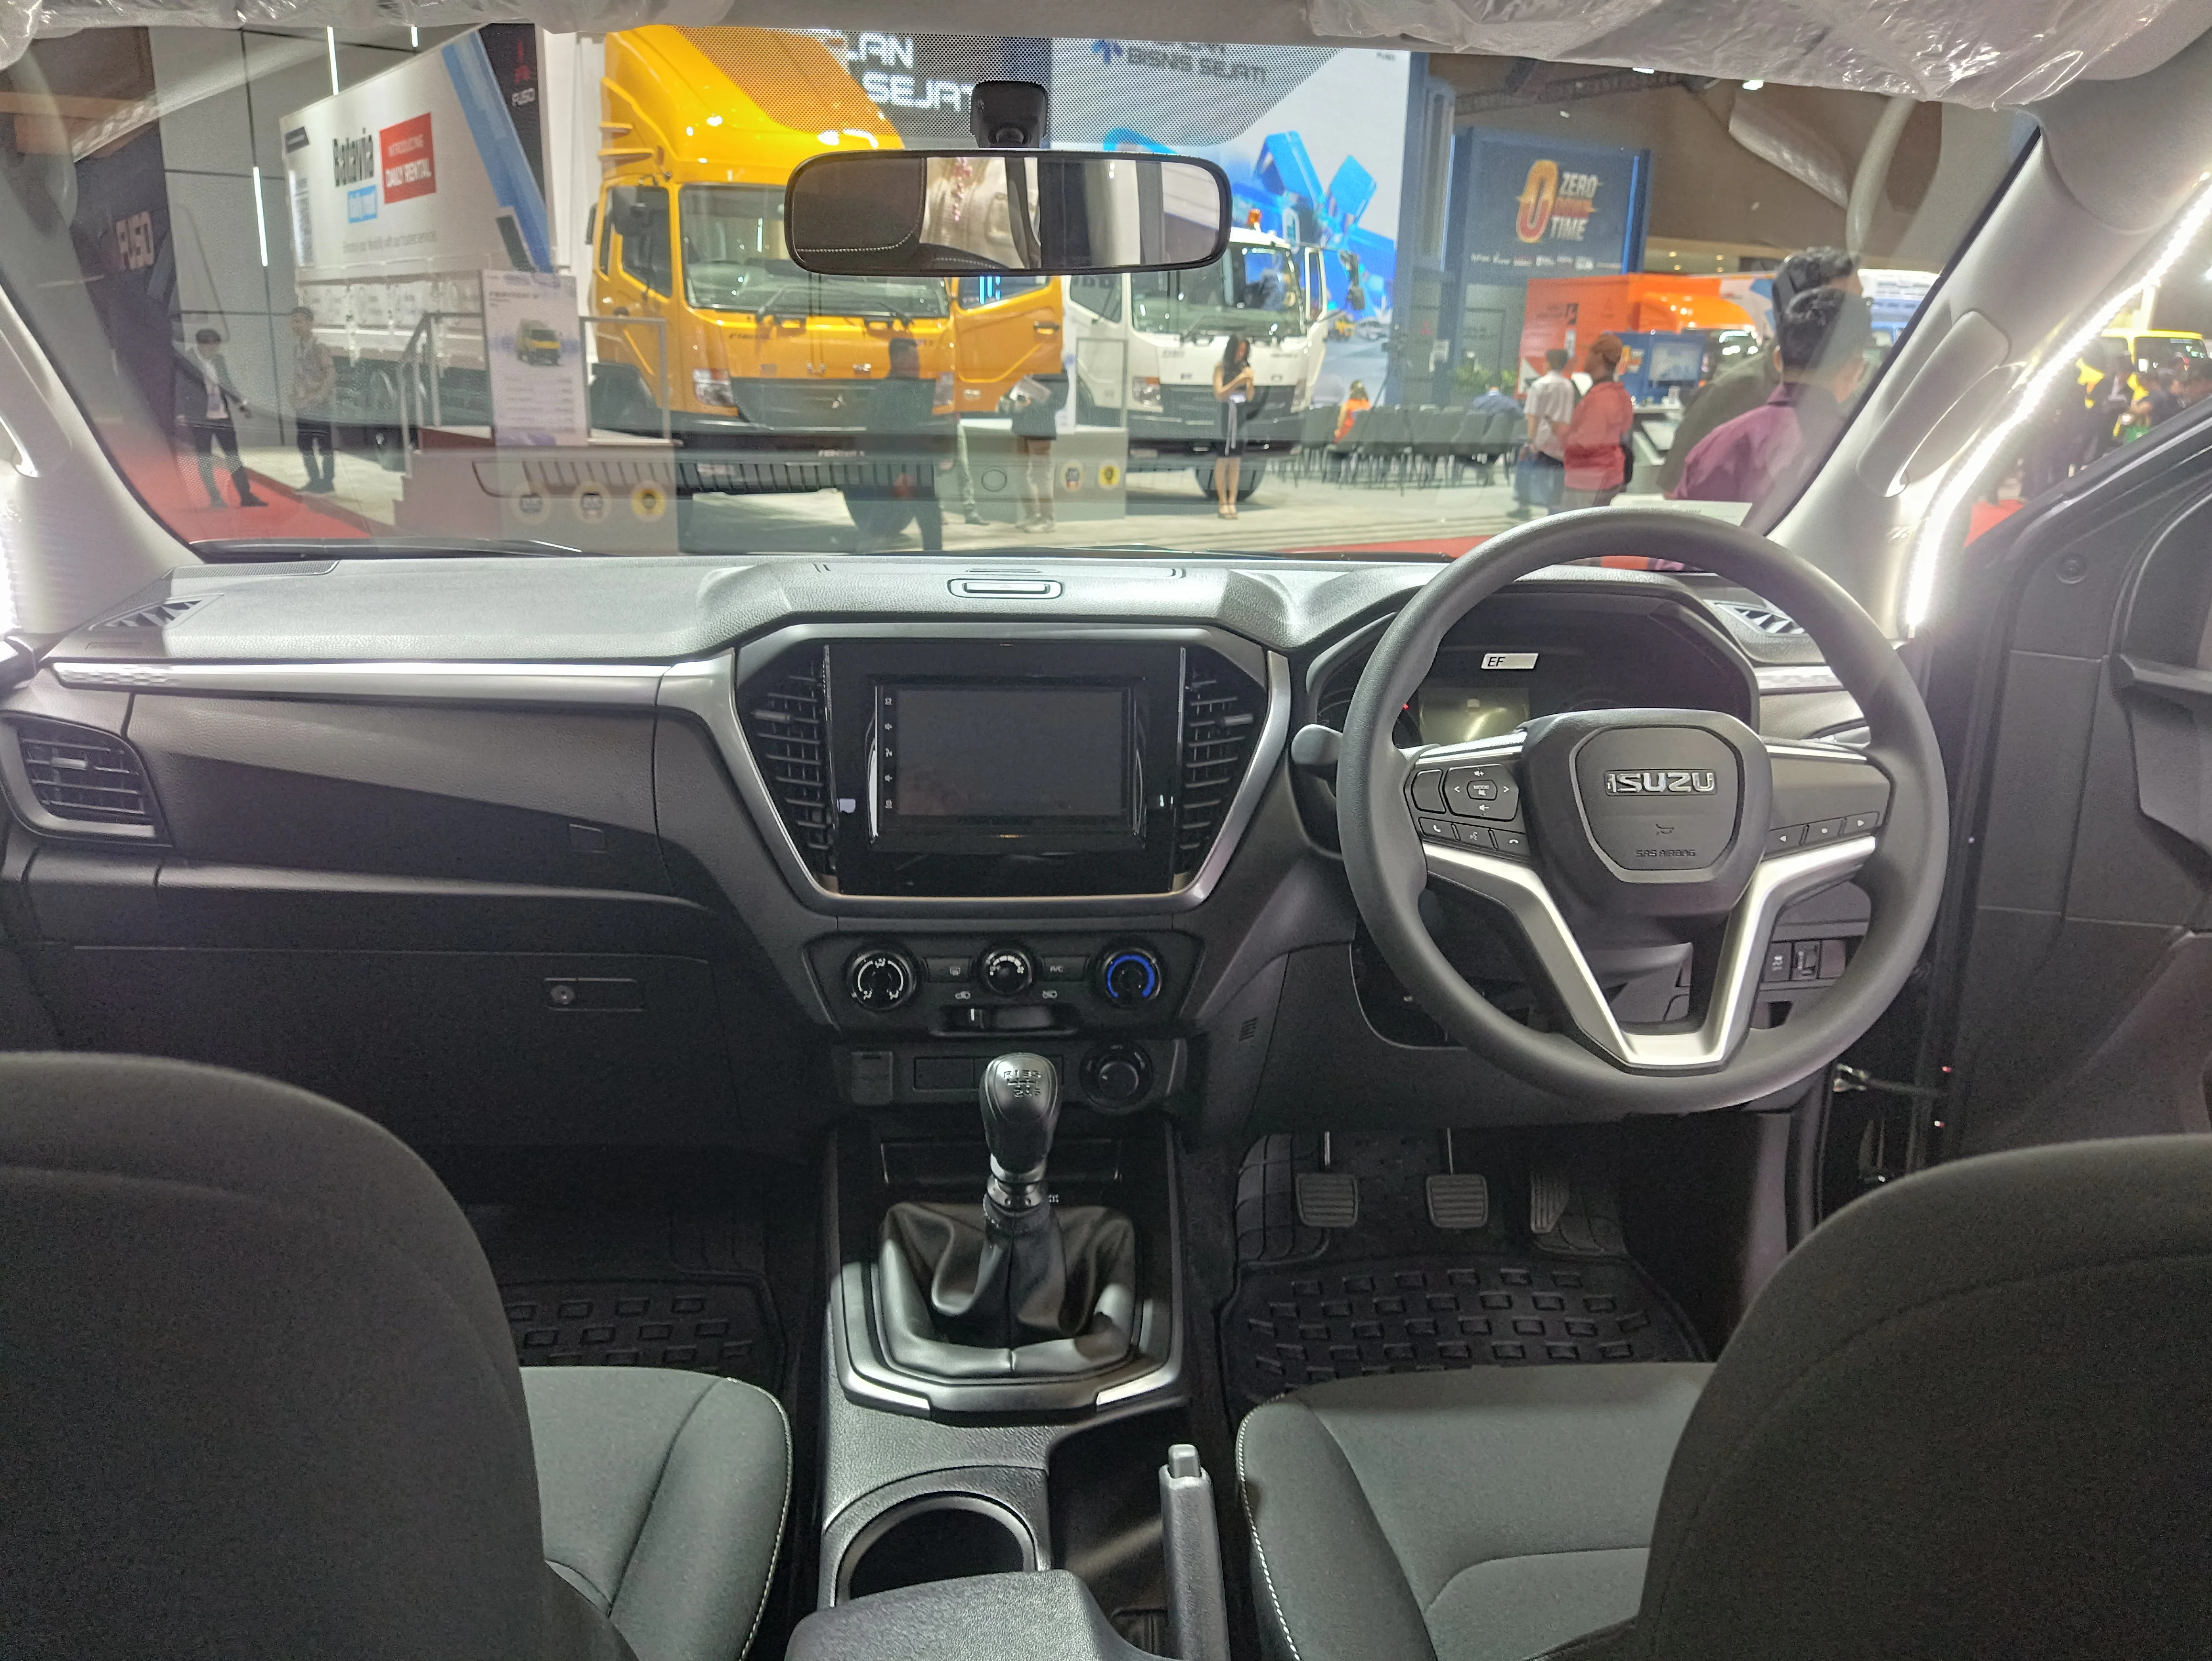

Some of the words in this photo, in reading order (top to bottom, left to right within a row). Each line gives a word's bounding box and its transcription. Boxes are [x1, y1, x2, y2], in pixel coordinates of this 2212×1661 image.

[511, 88, 536, 107] FUSO
[863, 70, 977, 113] SEJAT
[386, 166, 403, 188] DAILY
[404, 157, 432, 184] RENTAL
[1559, 171, 1599, 199] ZERO
[1549, 215, 1589, 241] TIME
[1488, 657, 1505, 666] EF
[1607, 772, 1714, 793] ISUZU
[1659, 849, 1696, 857] AIRBAG
